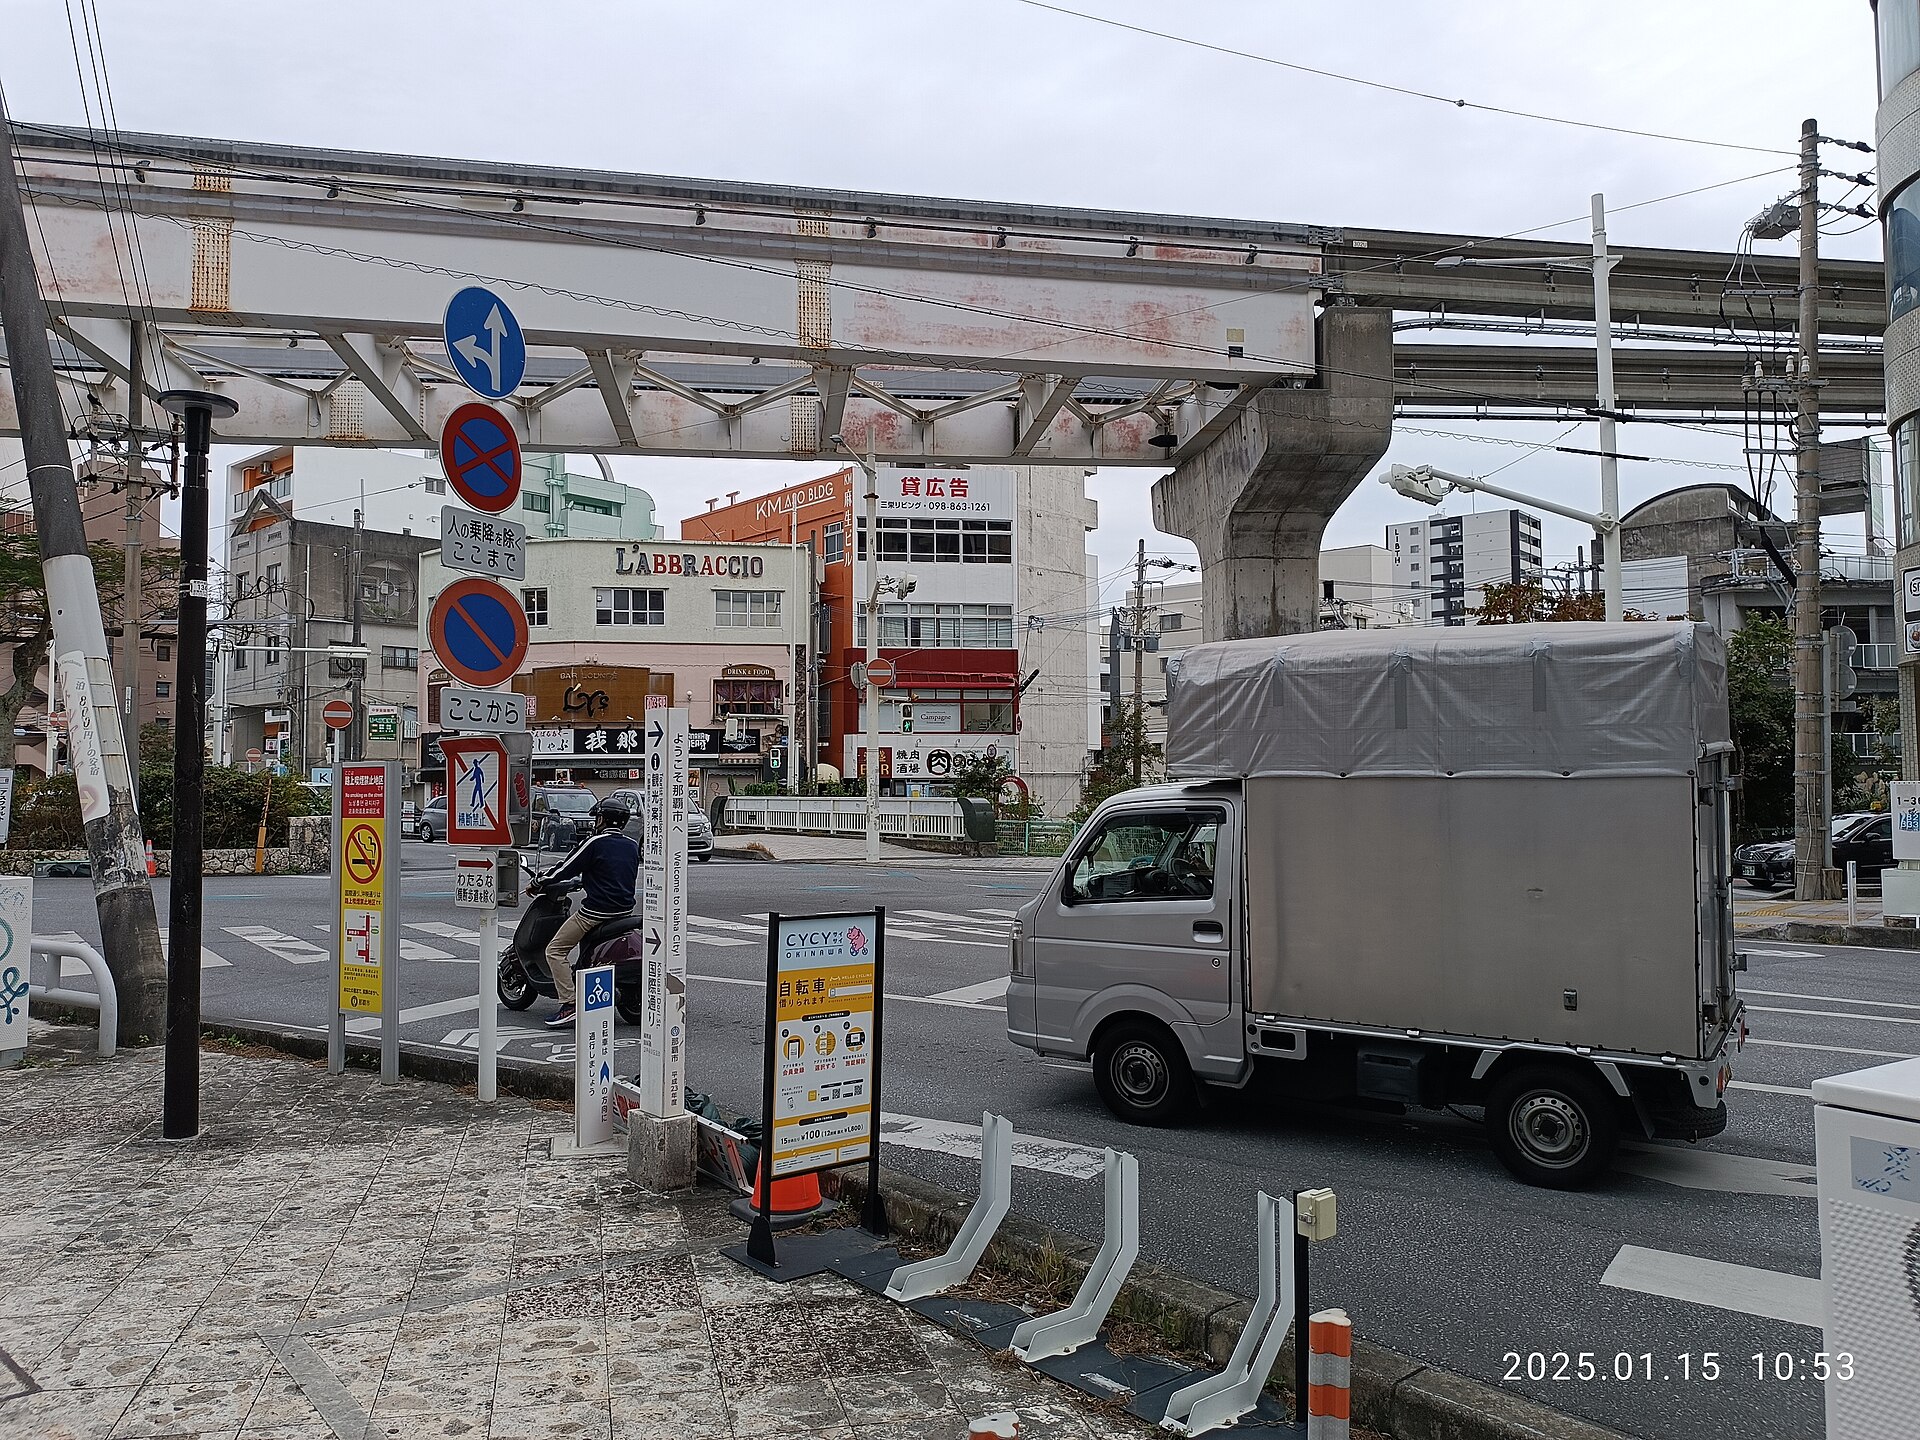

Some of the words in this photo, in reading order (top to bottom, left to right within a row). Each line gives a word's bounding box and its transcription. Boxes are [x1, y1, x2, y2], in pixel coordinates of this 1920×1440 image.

[808, 482, 834, 502] BLDG
[900, 477, 969, 498] 貸広告
[447, 514, 523, 552] 人の乗降を除く
[453, 541, 518, 573] ここまで
[615, 543, 764, 578] L'ABBRACCIO
[560, 672, 578, 680] BAR
[753, 668, 770, 676] FOOD
[449, 697, 520, 725] ここから
[920, 713, 952, 722] Campagne
[532, 738, 569, 752] しゃぶ
[896, 749, 920, 761] 焼肉
[860, 763, 889, 775] BR
[896, 763, 921, 774] 酒場
[672, 732, 684, 834] ようこそ那覇市へ
[458, 812, 487, 828] 横断禁止
[456, 872, 494, 888] わたるな
[672, 851, 682, 893] Welcome
[673, 895, 681, 906] to
[672, 908, 681, 932] Naha
[786, 931, 832, 947] CYCY
[786, 947, 843, 959] OKINAWA
[647, 960, 657, 1028] 国際通り
[779, 976, 826, 998] 自転車
[779, 996, 826, 1008] 借りられます
[814, 1062, 836, 1072] 選択する
[800, 1129, 821, 1141] ¥100
